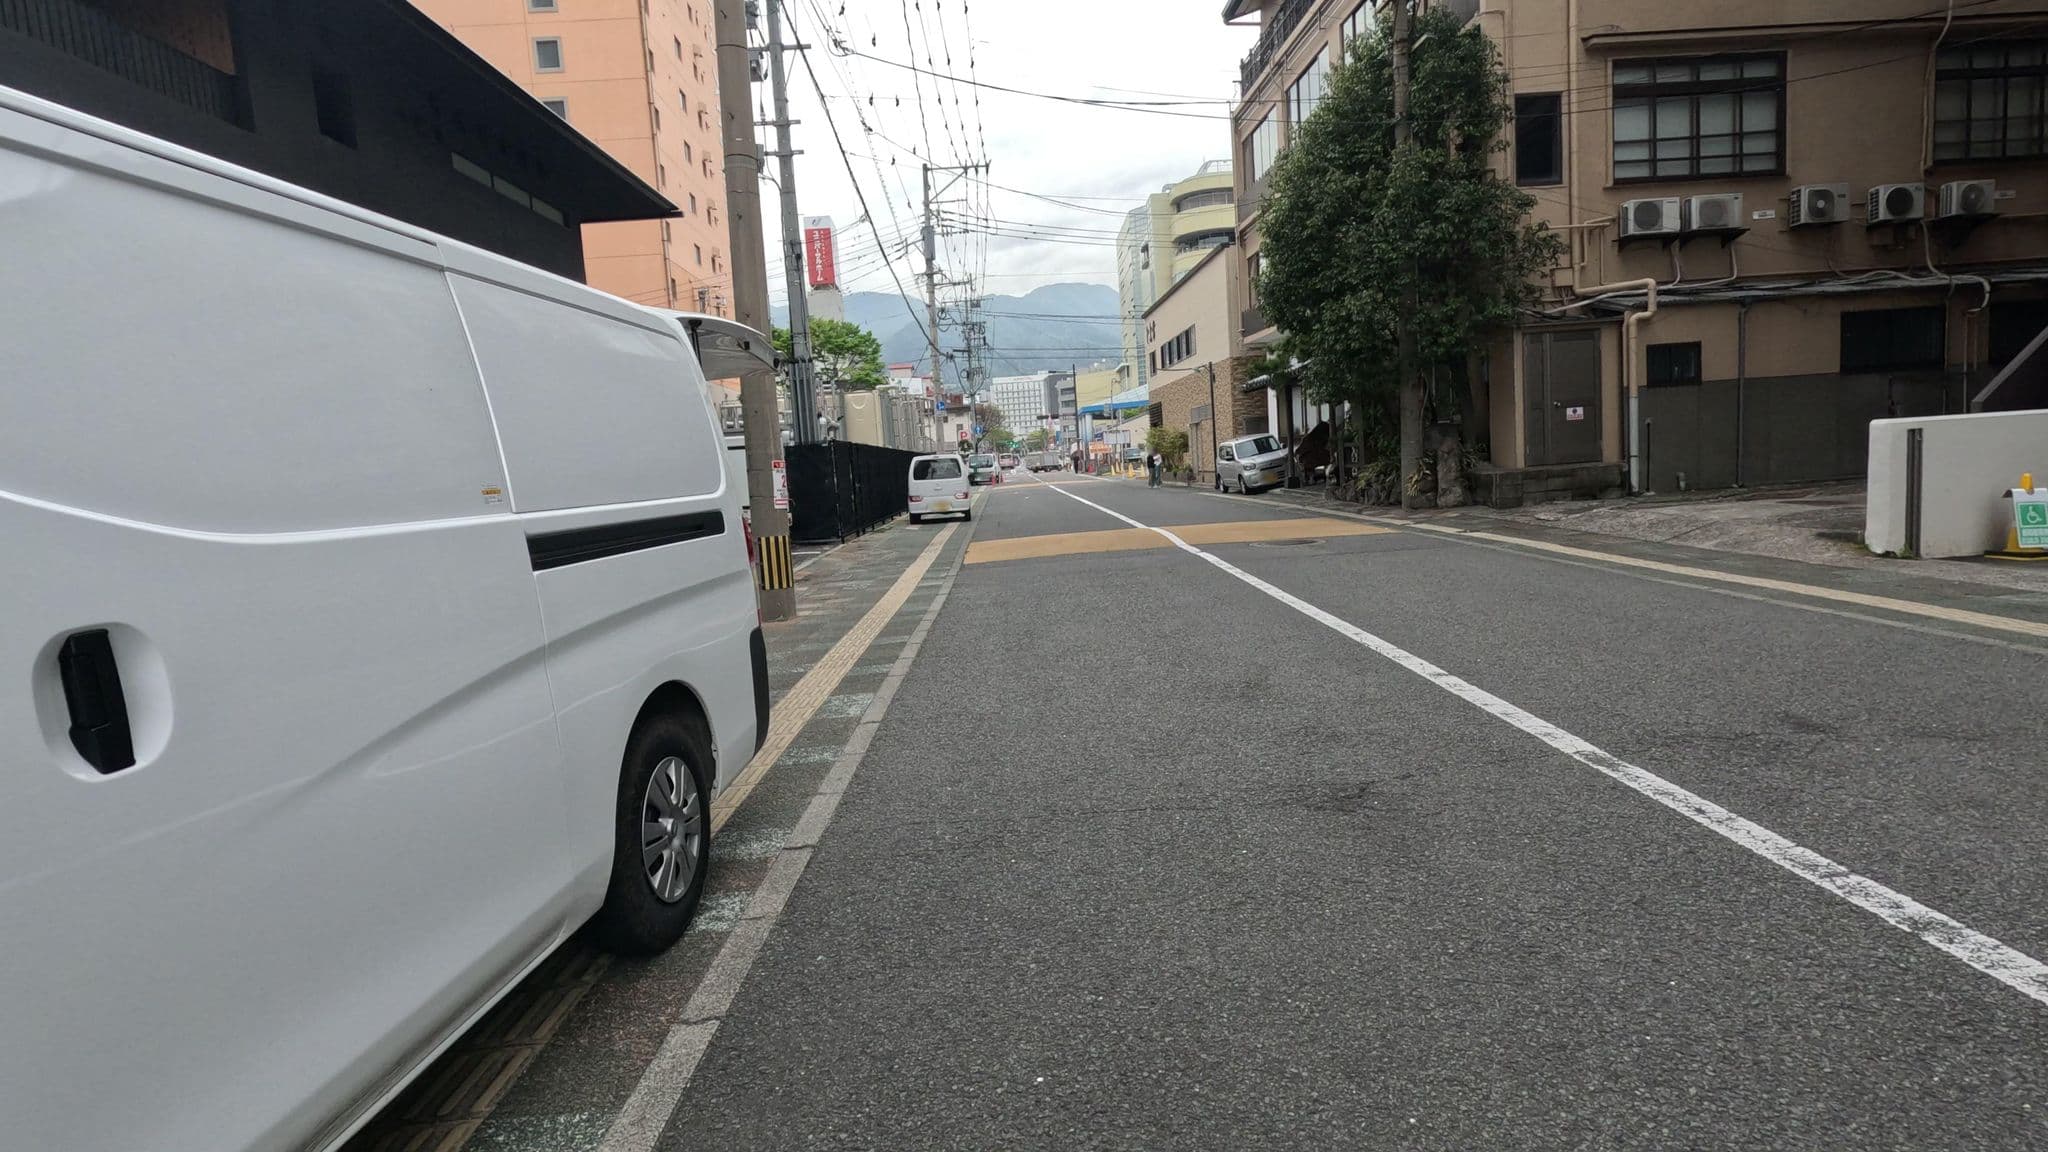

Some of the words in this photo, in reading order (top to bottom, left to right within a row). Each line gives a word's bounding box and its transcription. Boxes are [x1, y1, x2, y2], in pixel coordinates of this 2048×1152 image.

[813, 230, 824, 281] ユニバーサルホーム
[960, 431, 968, 439] P
